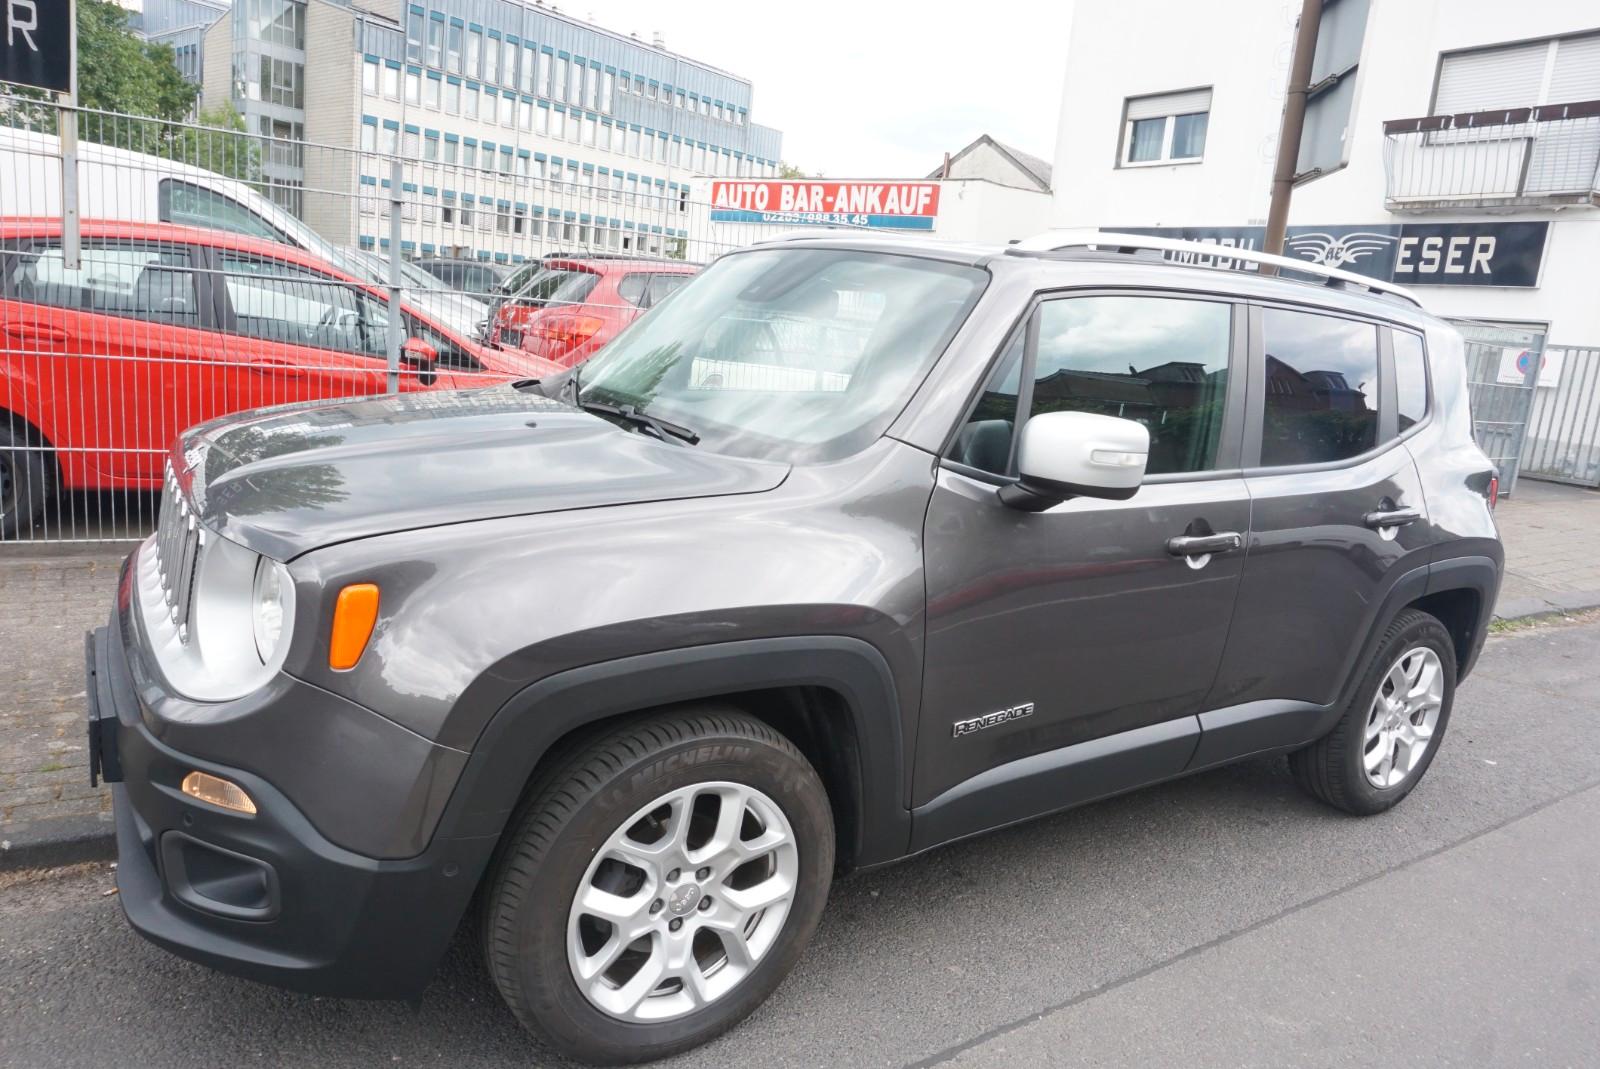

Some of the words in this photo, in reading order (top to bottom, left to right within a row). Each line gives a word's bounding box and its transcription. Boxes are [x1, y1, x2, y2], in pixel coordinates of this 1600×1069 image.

[7, 0, 39, 51] R
[714, 183, 770, 210] AUTO
[780, 184, 933, 215] BAR-ANKAUF
[1395, 236, 1497, 274] ESER
[953, 702, 1035, 738] RENEGADE
